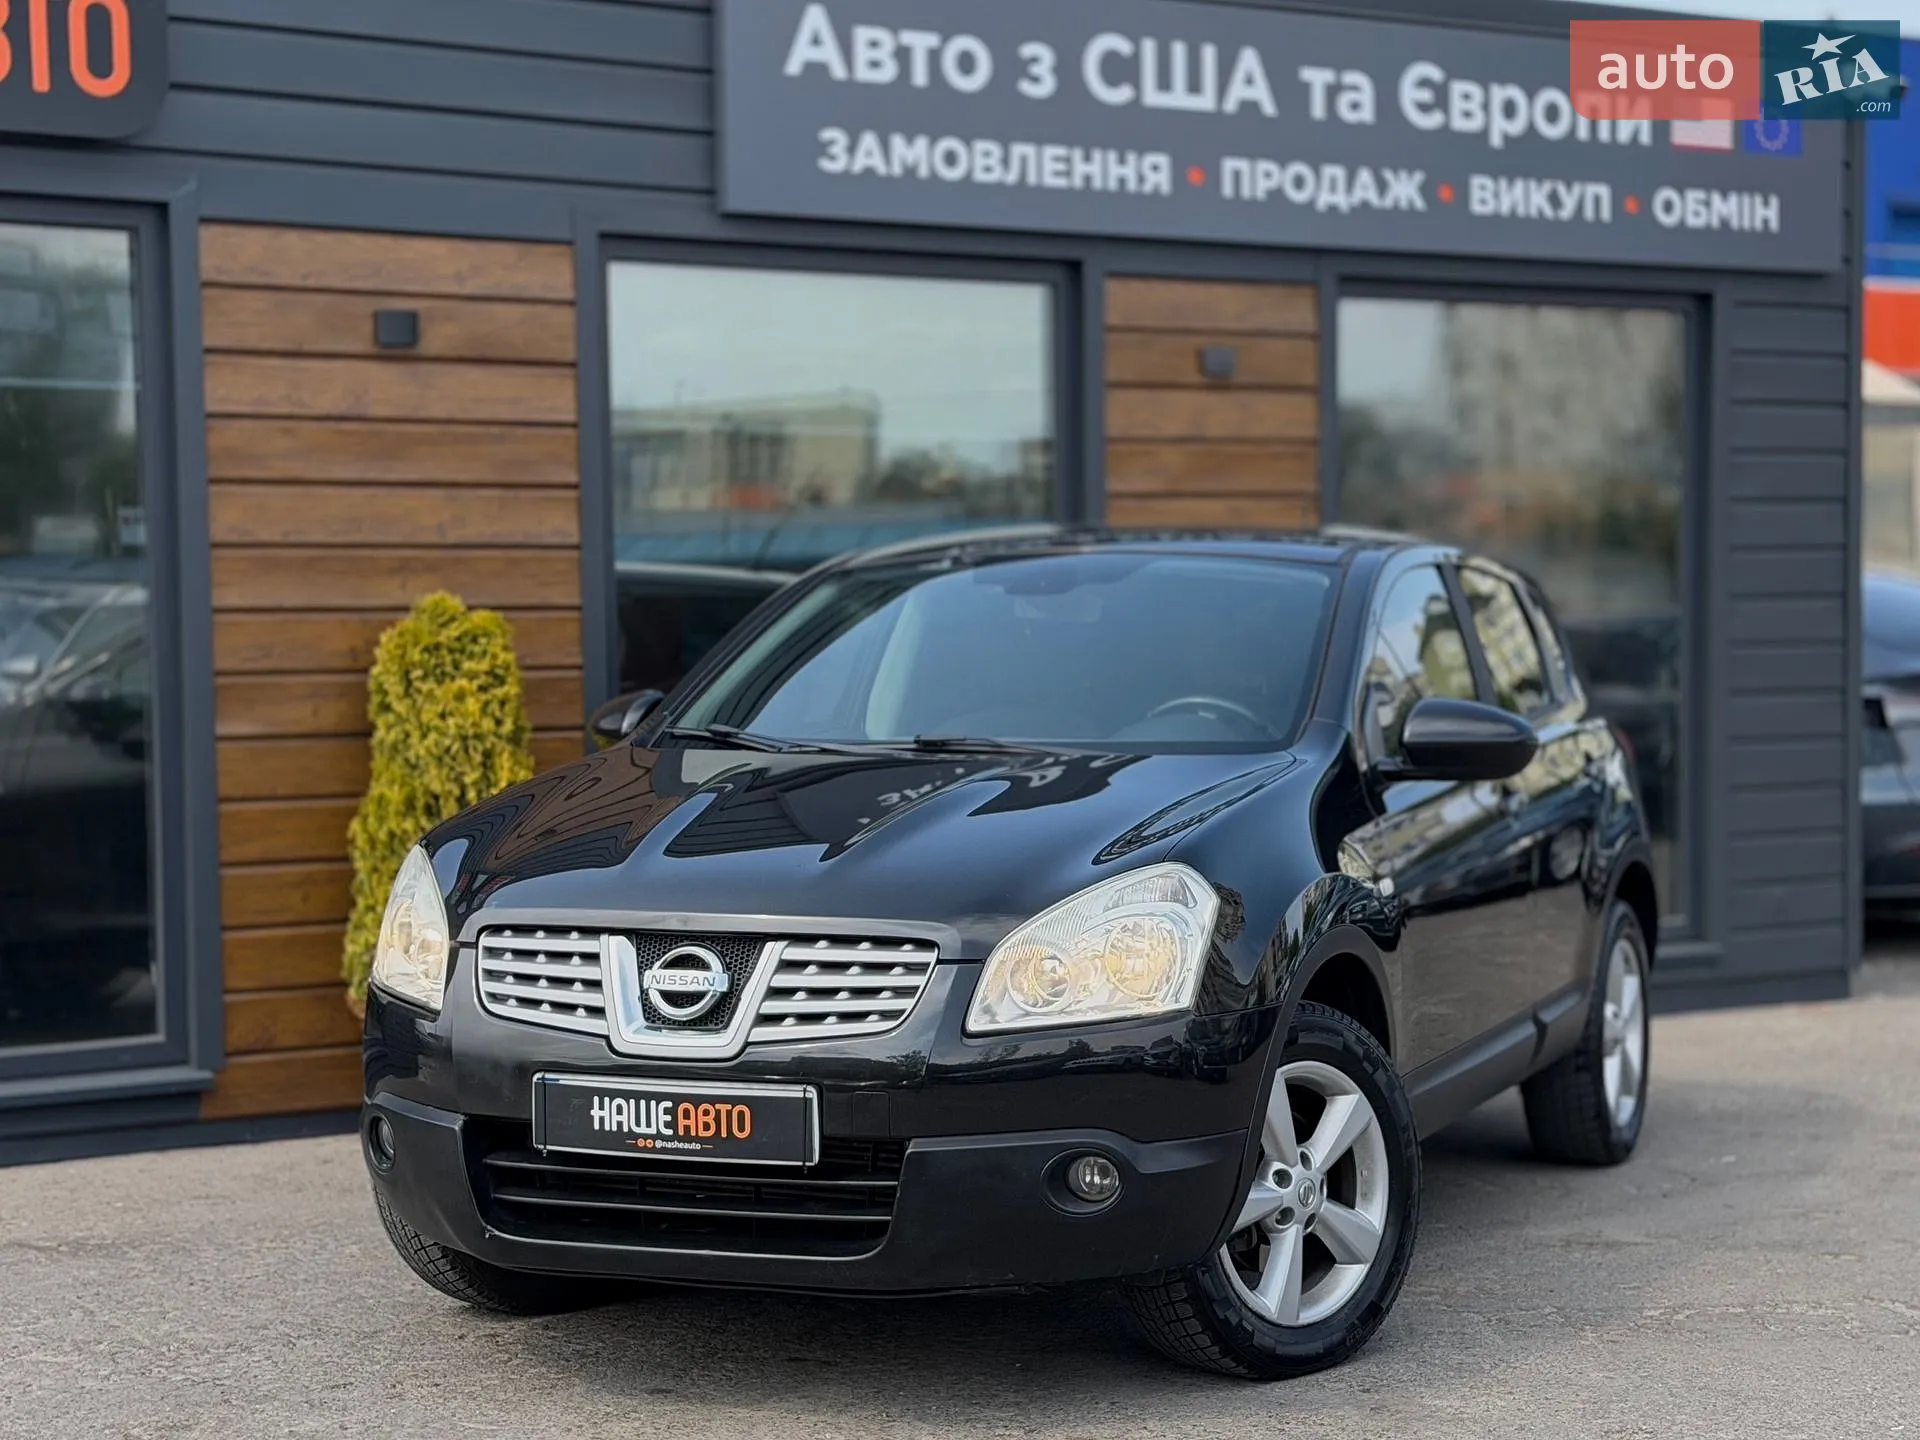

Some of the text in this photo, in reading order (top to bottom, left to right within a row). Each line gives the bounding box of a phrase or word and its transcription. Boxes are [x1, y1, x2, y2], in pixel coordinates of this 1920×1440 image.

[783, 2, 1653, 149] Авто з США та Європи
[816, 126, 1781, 234] ЗАМОВЛЕННЯ ПРОДАЖ ВИКУП ОБМІН
[650, 974, 717, 987] NISSAN
[590, 1095, 752, 1139] НАШЕ АВТО
[654, 1139, 702, 1150] @nasheauto
